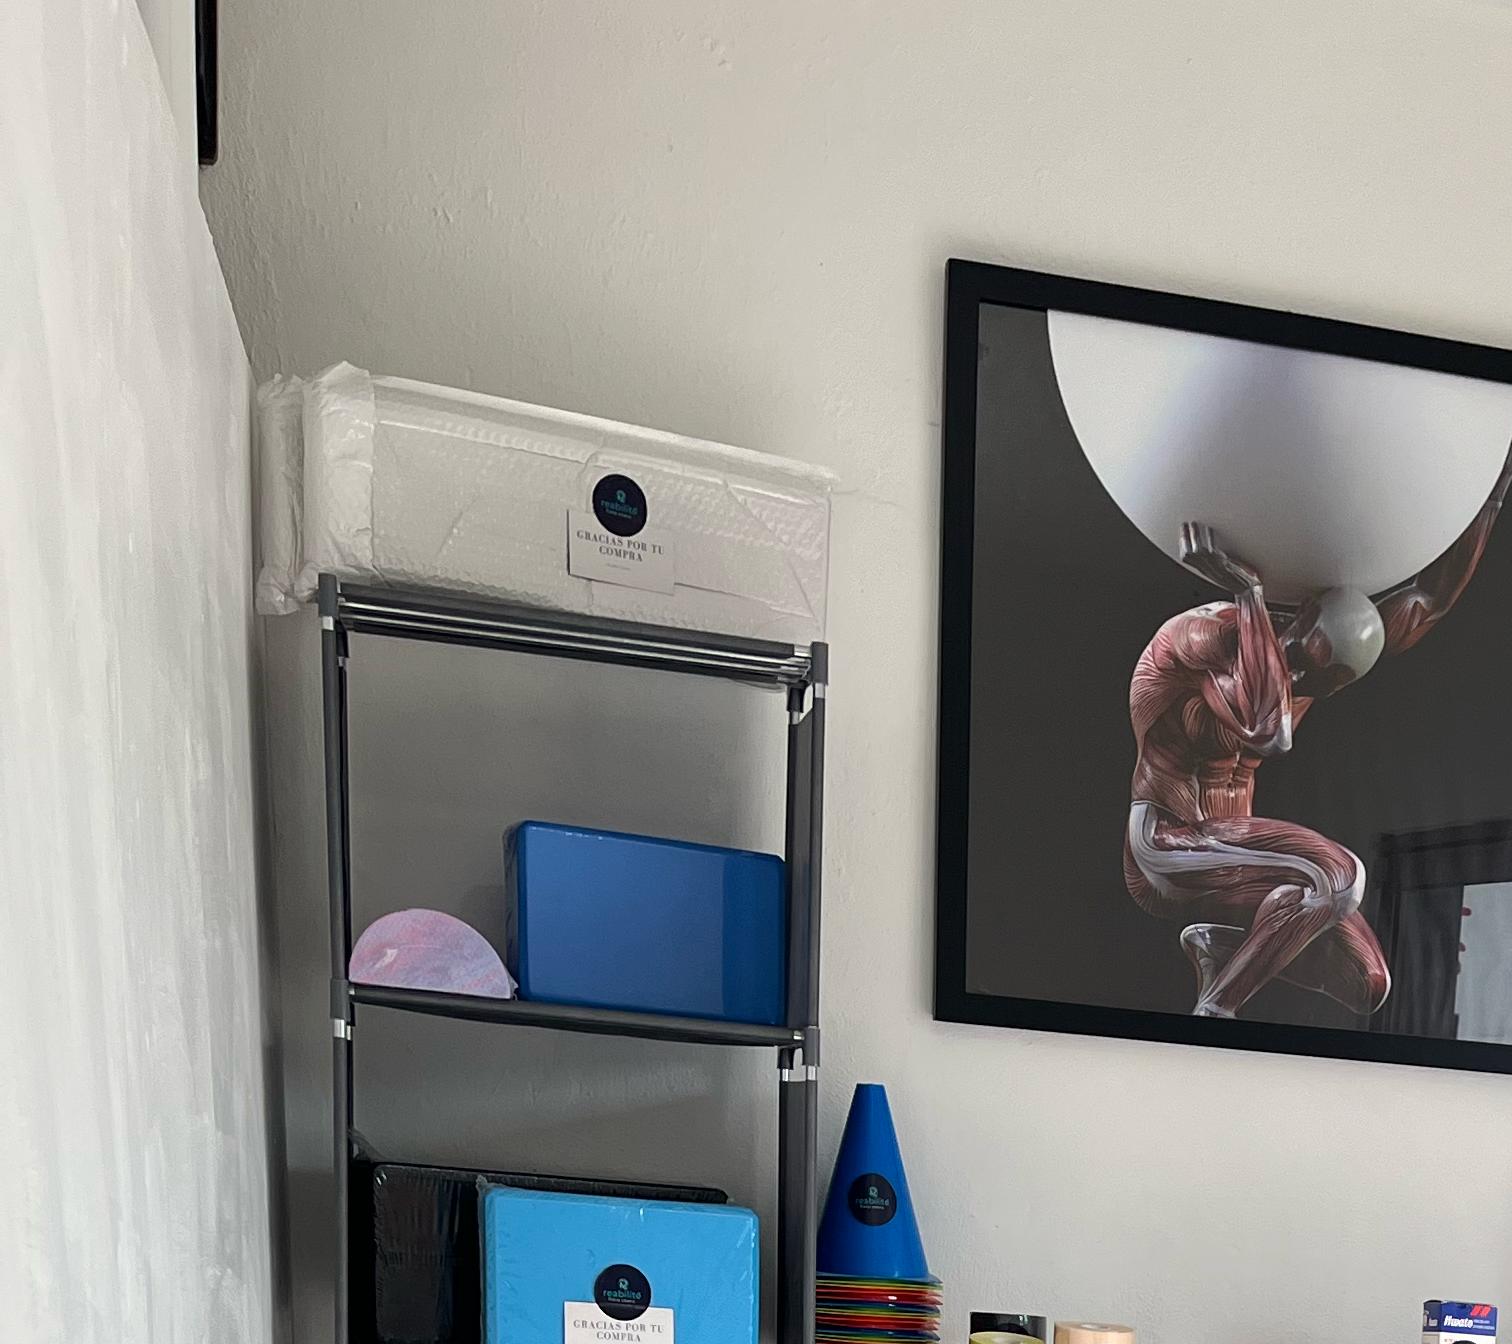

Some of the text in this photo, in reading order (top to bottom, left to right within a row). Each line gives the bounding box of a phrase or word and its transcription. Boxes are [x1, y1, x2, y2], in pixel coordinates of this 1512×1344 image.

[576, 530, 665, 556] GRACIAS POR TU
[599, 545, 643, 562] COMPRA
[573, 1319, 665, 1334] GRACIAS POR TU
[596, 1331, 642, 1343] COMPRA
